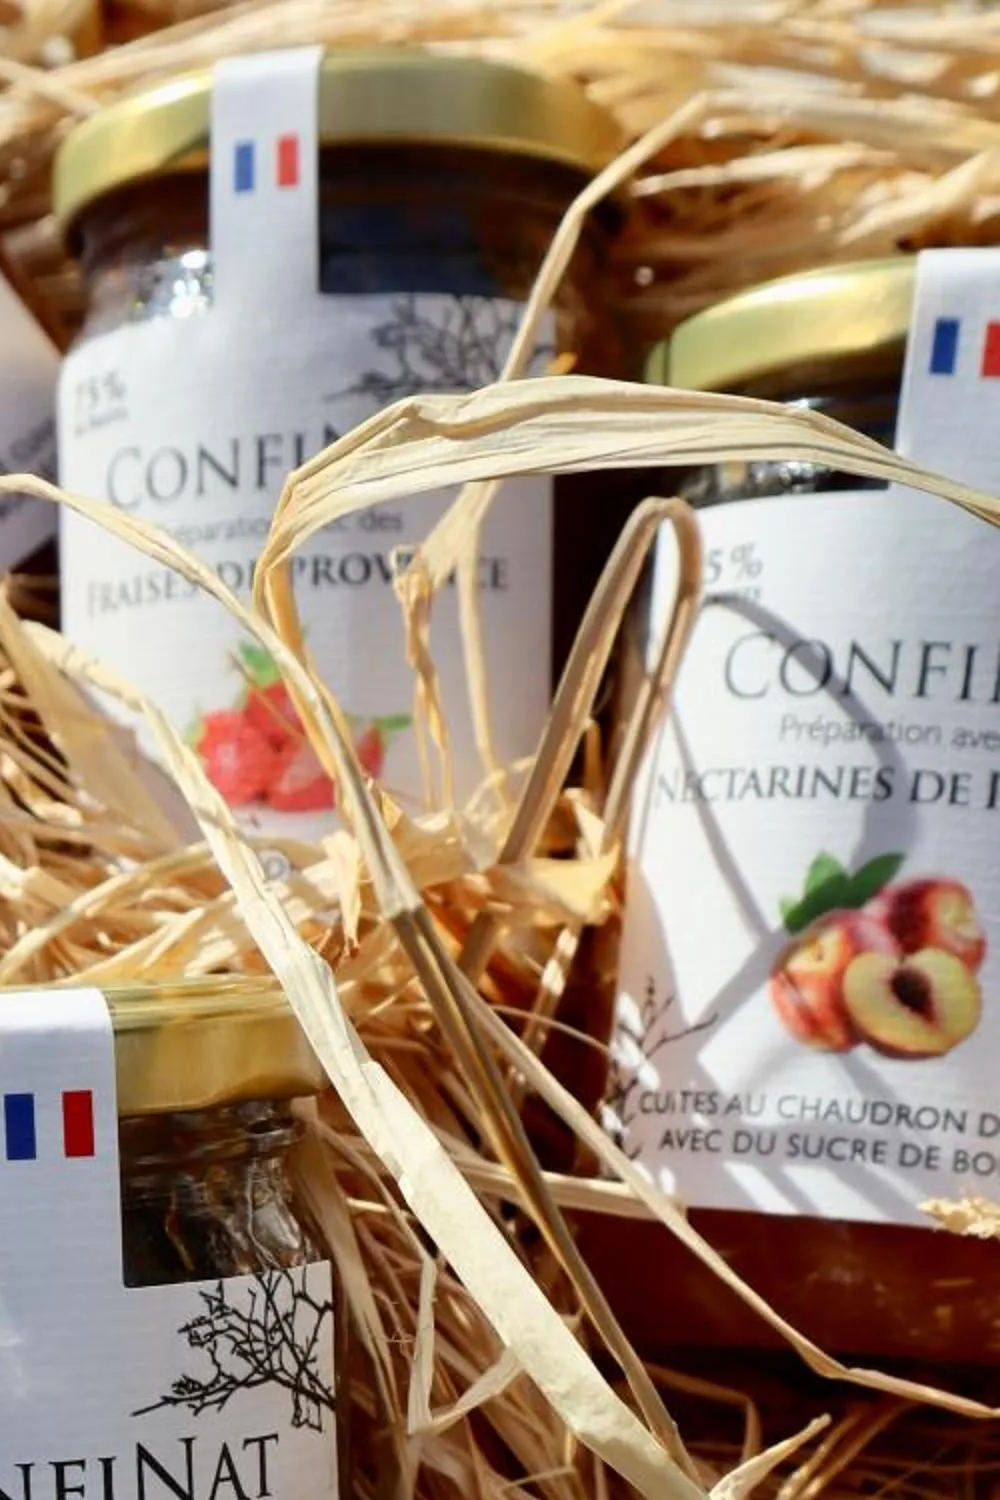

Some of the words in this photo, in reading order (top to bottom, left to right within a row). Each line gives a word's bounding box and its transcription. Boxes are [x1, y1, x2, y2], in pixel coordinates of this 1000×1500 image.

[105, 421, 348, 509] CONFI
[704, 541, 764, 585] 5%
[87, 567, 204, 619] FRAISE
[724, 629, 1000, 705] CONFI
[778, 712, 943, 748] Préparation
[655, 764, 896, 808] NECTARINES
[908, 768, 973, 806] DE
[638, 1089, 719, 1116] CUITES
[724, 1093, 766, 1117] AU
[777, 1094, 967, 1134] CHAUDRON
[659, 1129, 722, 1154] AVEC
[731, 1130, 777, 1156] DU
[786, 1132, 889, 1166] SUCRE
[898, 1141, 941, 1170] DE
